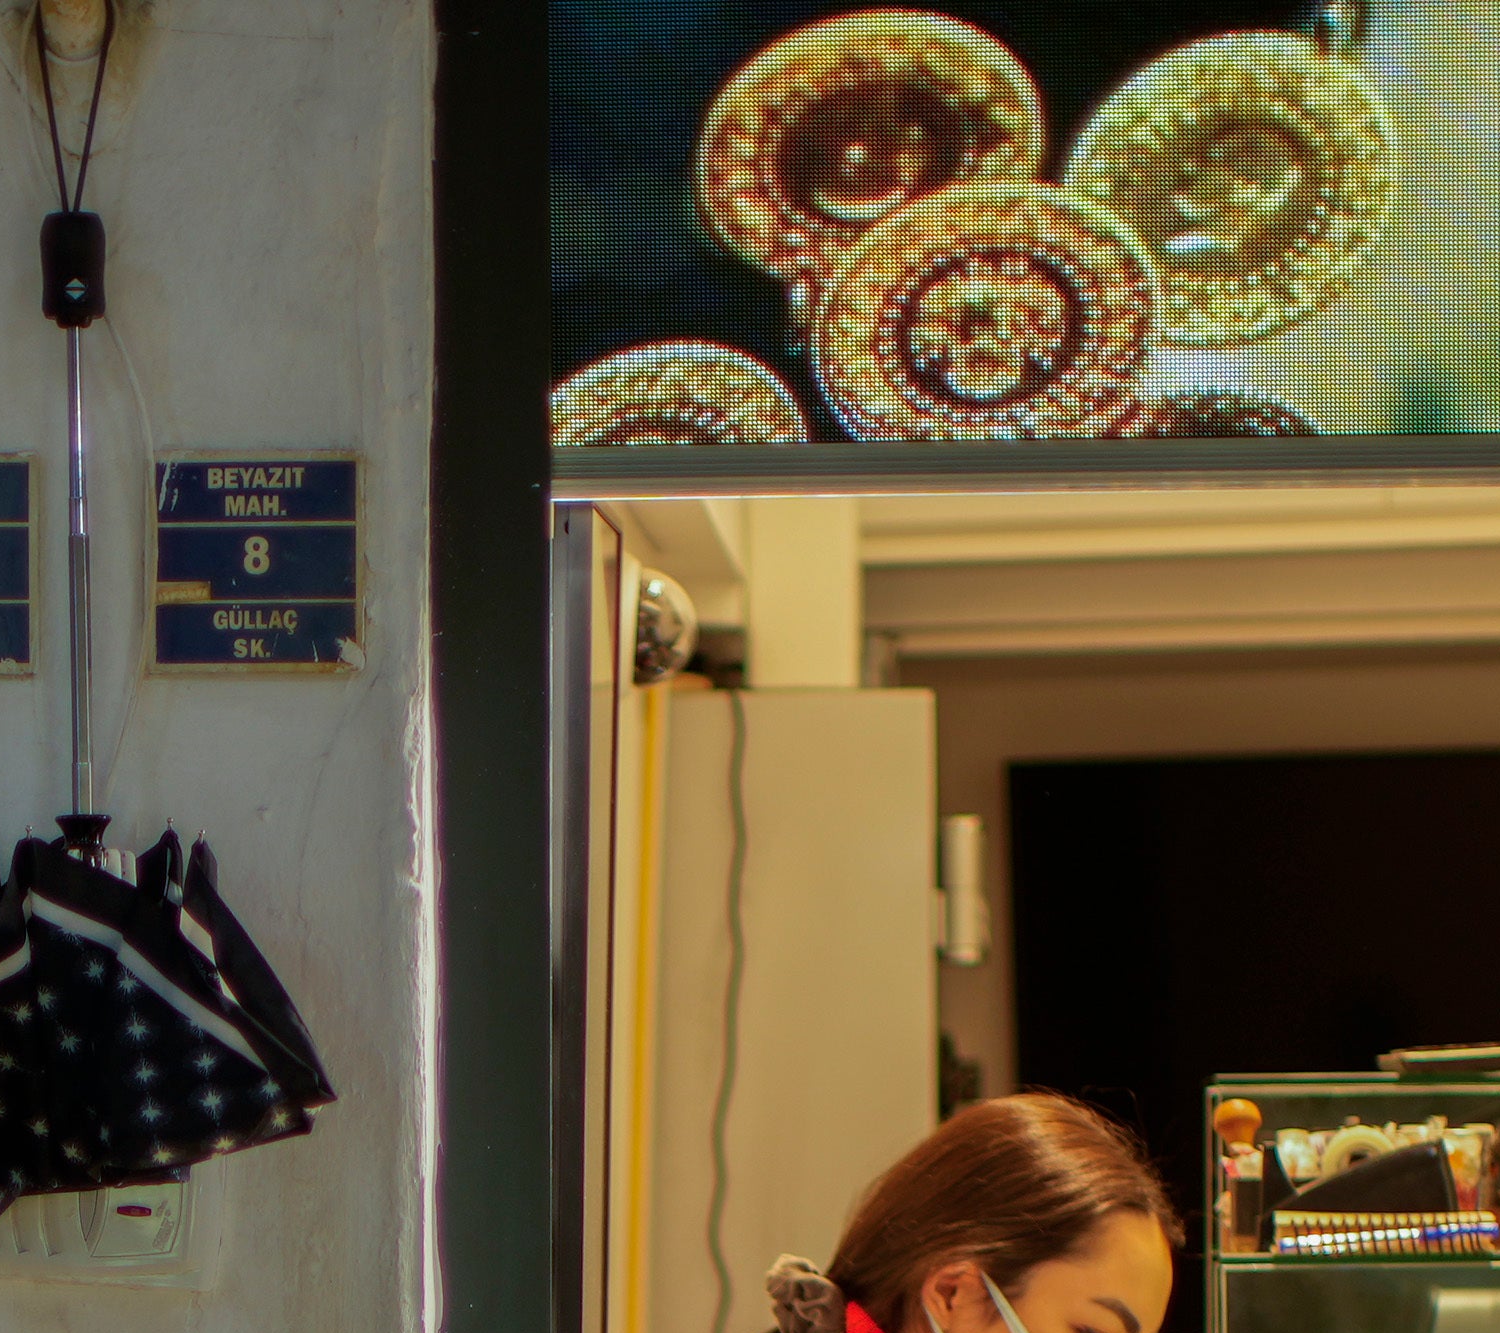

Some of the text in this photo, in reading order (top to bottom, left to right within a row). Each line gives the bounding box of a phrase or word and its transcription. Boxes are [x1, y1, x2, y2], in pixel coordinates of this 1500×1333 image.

[207, 467, 305, 488] BEYAZIT
[224, 496, 287, 516] MAH.
[243, 537, 270, 575] 8
[213, 605, 299, 635] GÜLLAÇ
[233, 640, 272, 658] SK.
